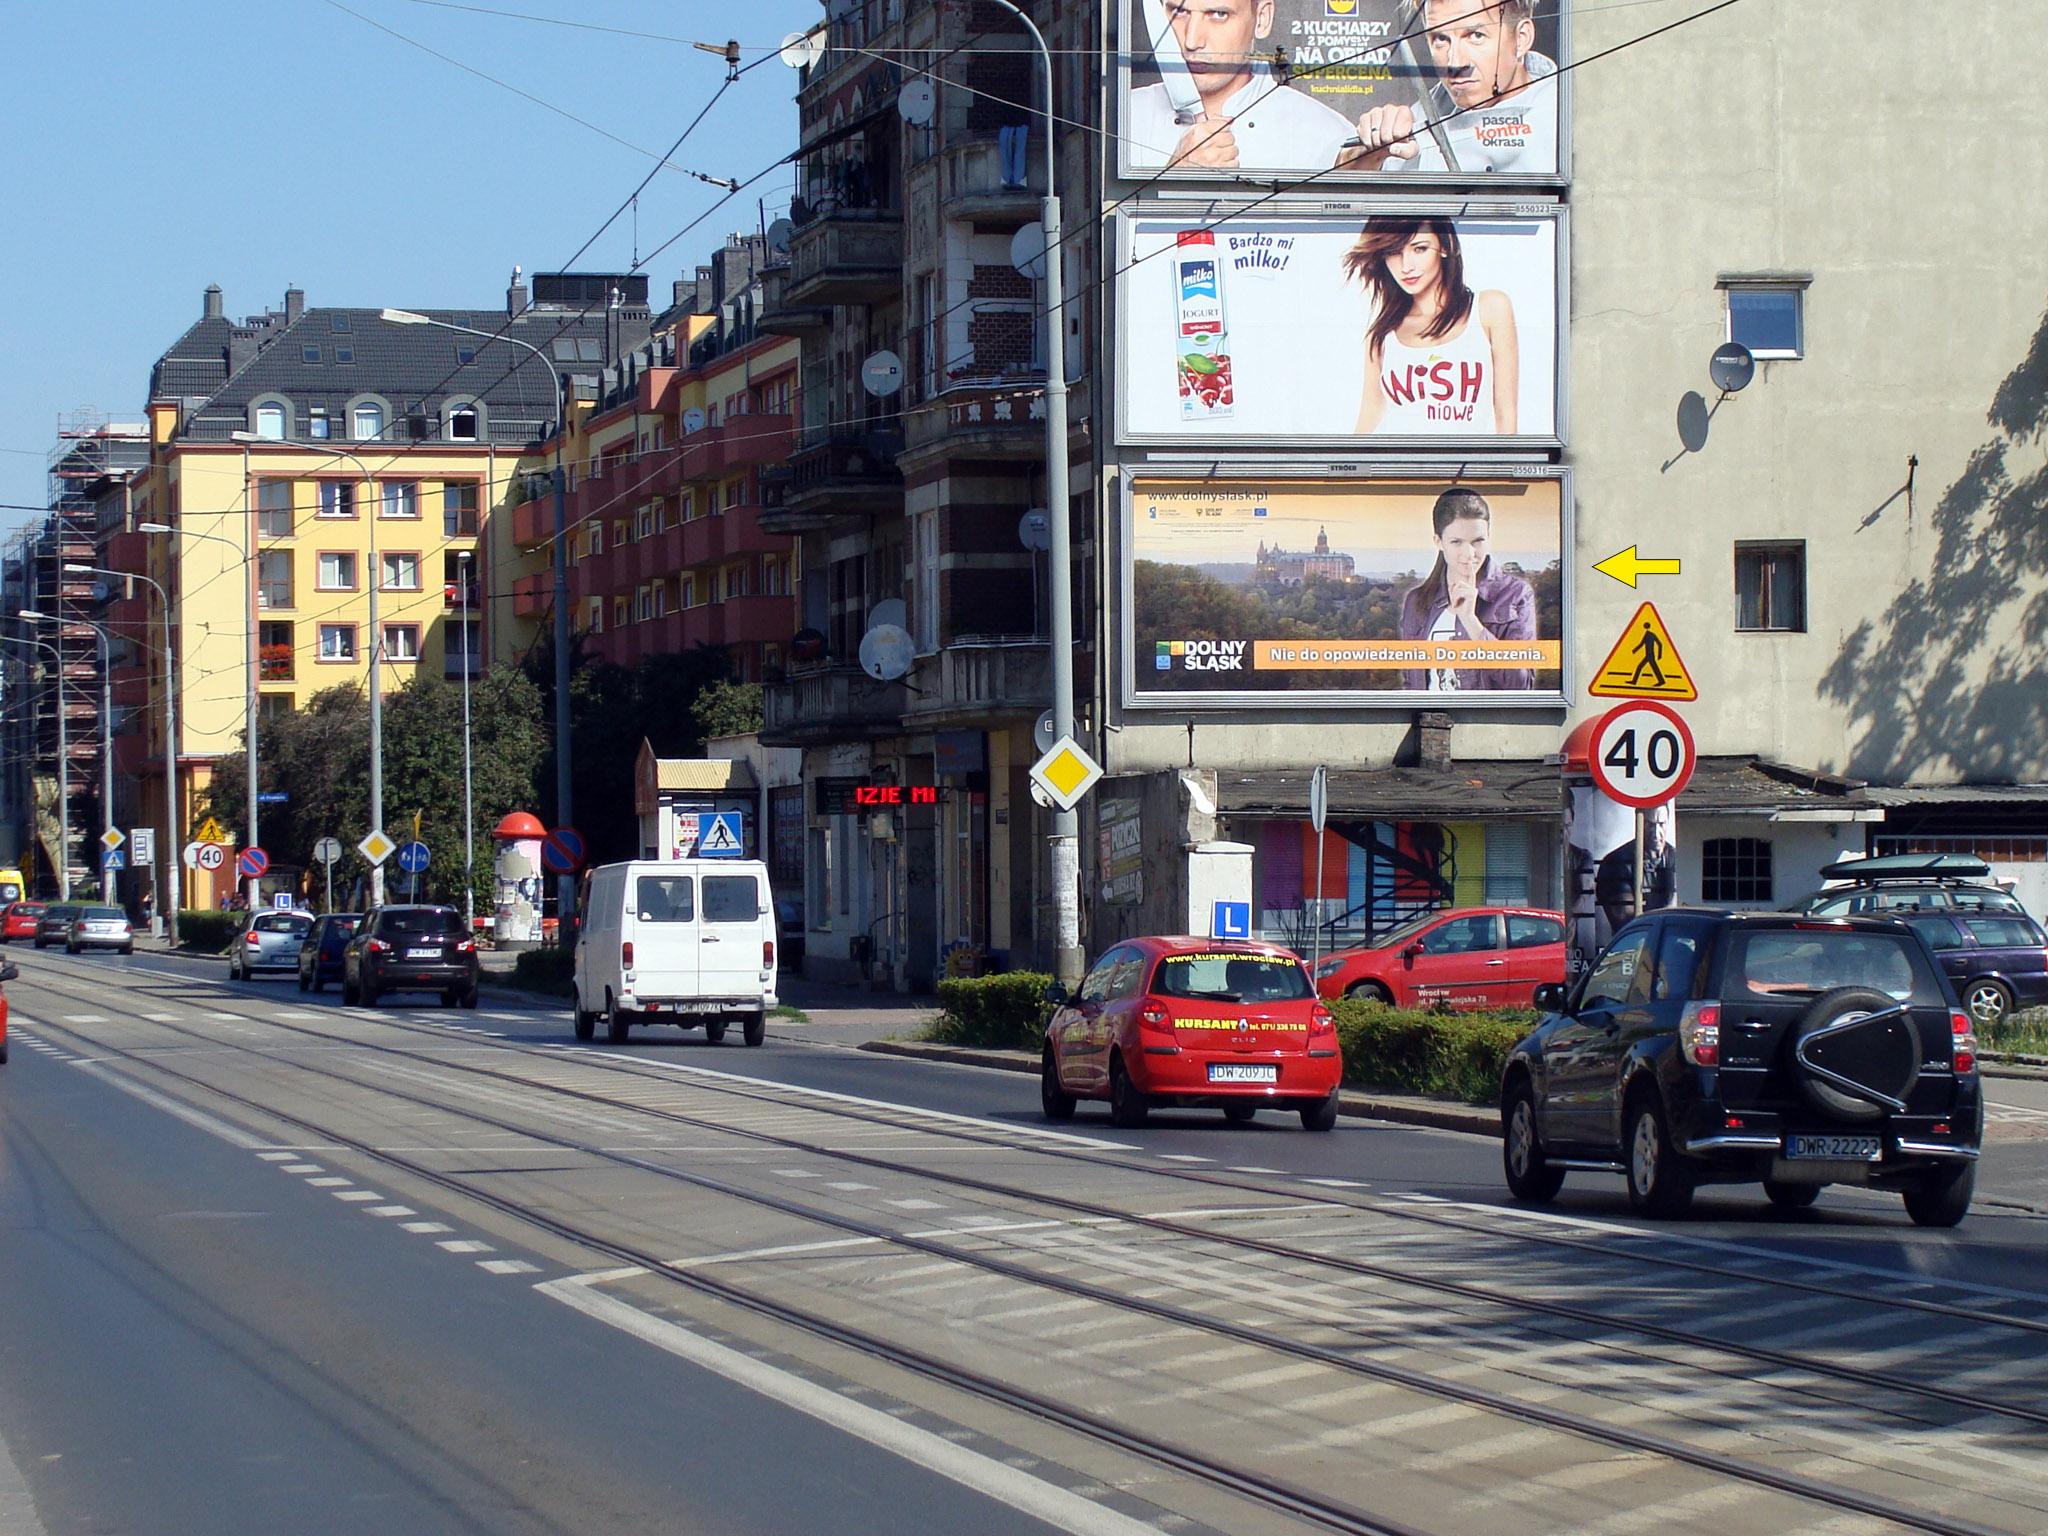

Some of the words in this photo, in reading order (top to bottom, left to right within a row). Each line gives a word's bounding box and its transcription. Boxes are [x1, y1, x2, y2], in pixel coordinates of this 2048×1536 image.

[1291, 20, 1302, 35] 2
[1303, 20, 1392, 36] KUCHARZY
[1308, 35, 1316, 46] 2
[1294, 46, 1325, 65] NA
[1327, 47, 1392, 65] OBIAD
[1292, 64, 1393, 80] SUPERCENA
[1482, 114, 1523, 127] pascal
[1475, 124, 1532, 140] kontra
[1482, 138, 1525, 147] okrasa
[1229, 231, 1273, 250] Bardzo
[1277, 237, 1295, 250] mi
[1234, 249, 1289, 271] milko!
[1183, 267, 1213, 287] milko
[1182, 308, 1219, 320] JOGURT
[1427, 402, 1474, 422] niowe
[1147, 490, 1268, 503] www.dolnyslask.pl
[1184, 640, 1247, 656] DOLNY
[1270, 648, 1296, 661] Nie
[1300, 647, 1319, 661] do
[1323, 647, 1431, 664] opowiedzenia.
[1435, 648, 1456, 662] Do
[1460, 647, 1546, 662] zobaczenia.
[1184, 654, 1243, 672] ŚLĄSK
[1604, 729, 1679, 779] 40
[202, 850, 221, 864] 40
[279, 897, 288, 907] L
[1225, 906, 1242, 933] L
[1174, 1018, 1238, 1030] KURSANT
[1216, 1065, 1234, 1078] DW
[1239, 1066, 1275, 1079] 209JC
[1796, 1138, 1826, 1154] DWR
[1831, 1138, 1878, 1155] 22223
